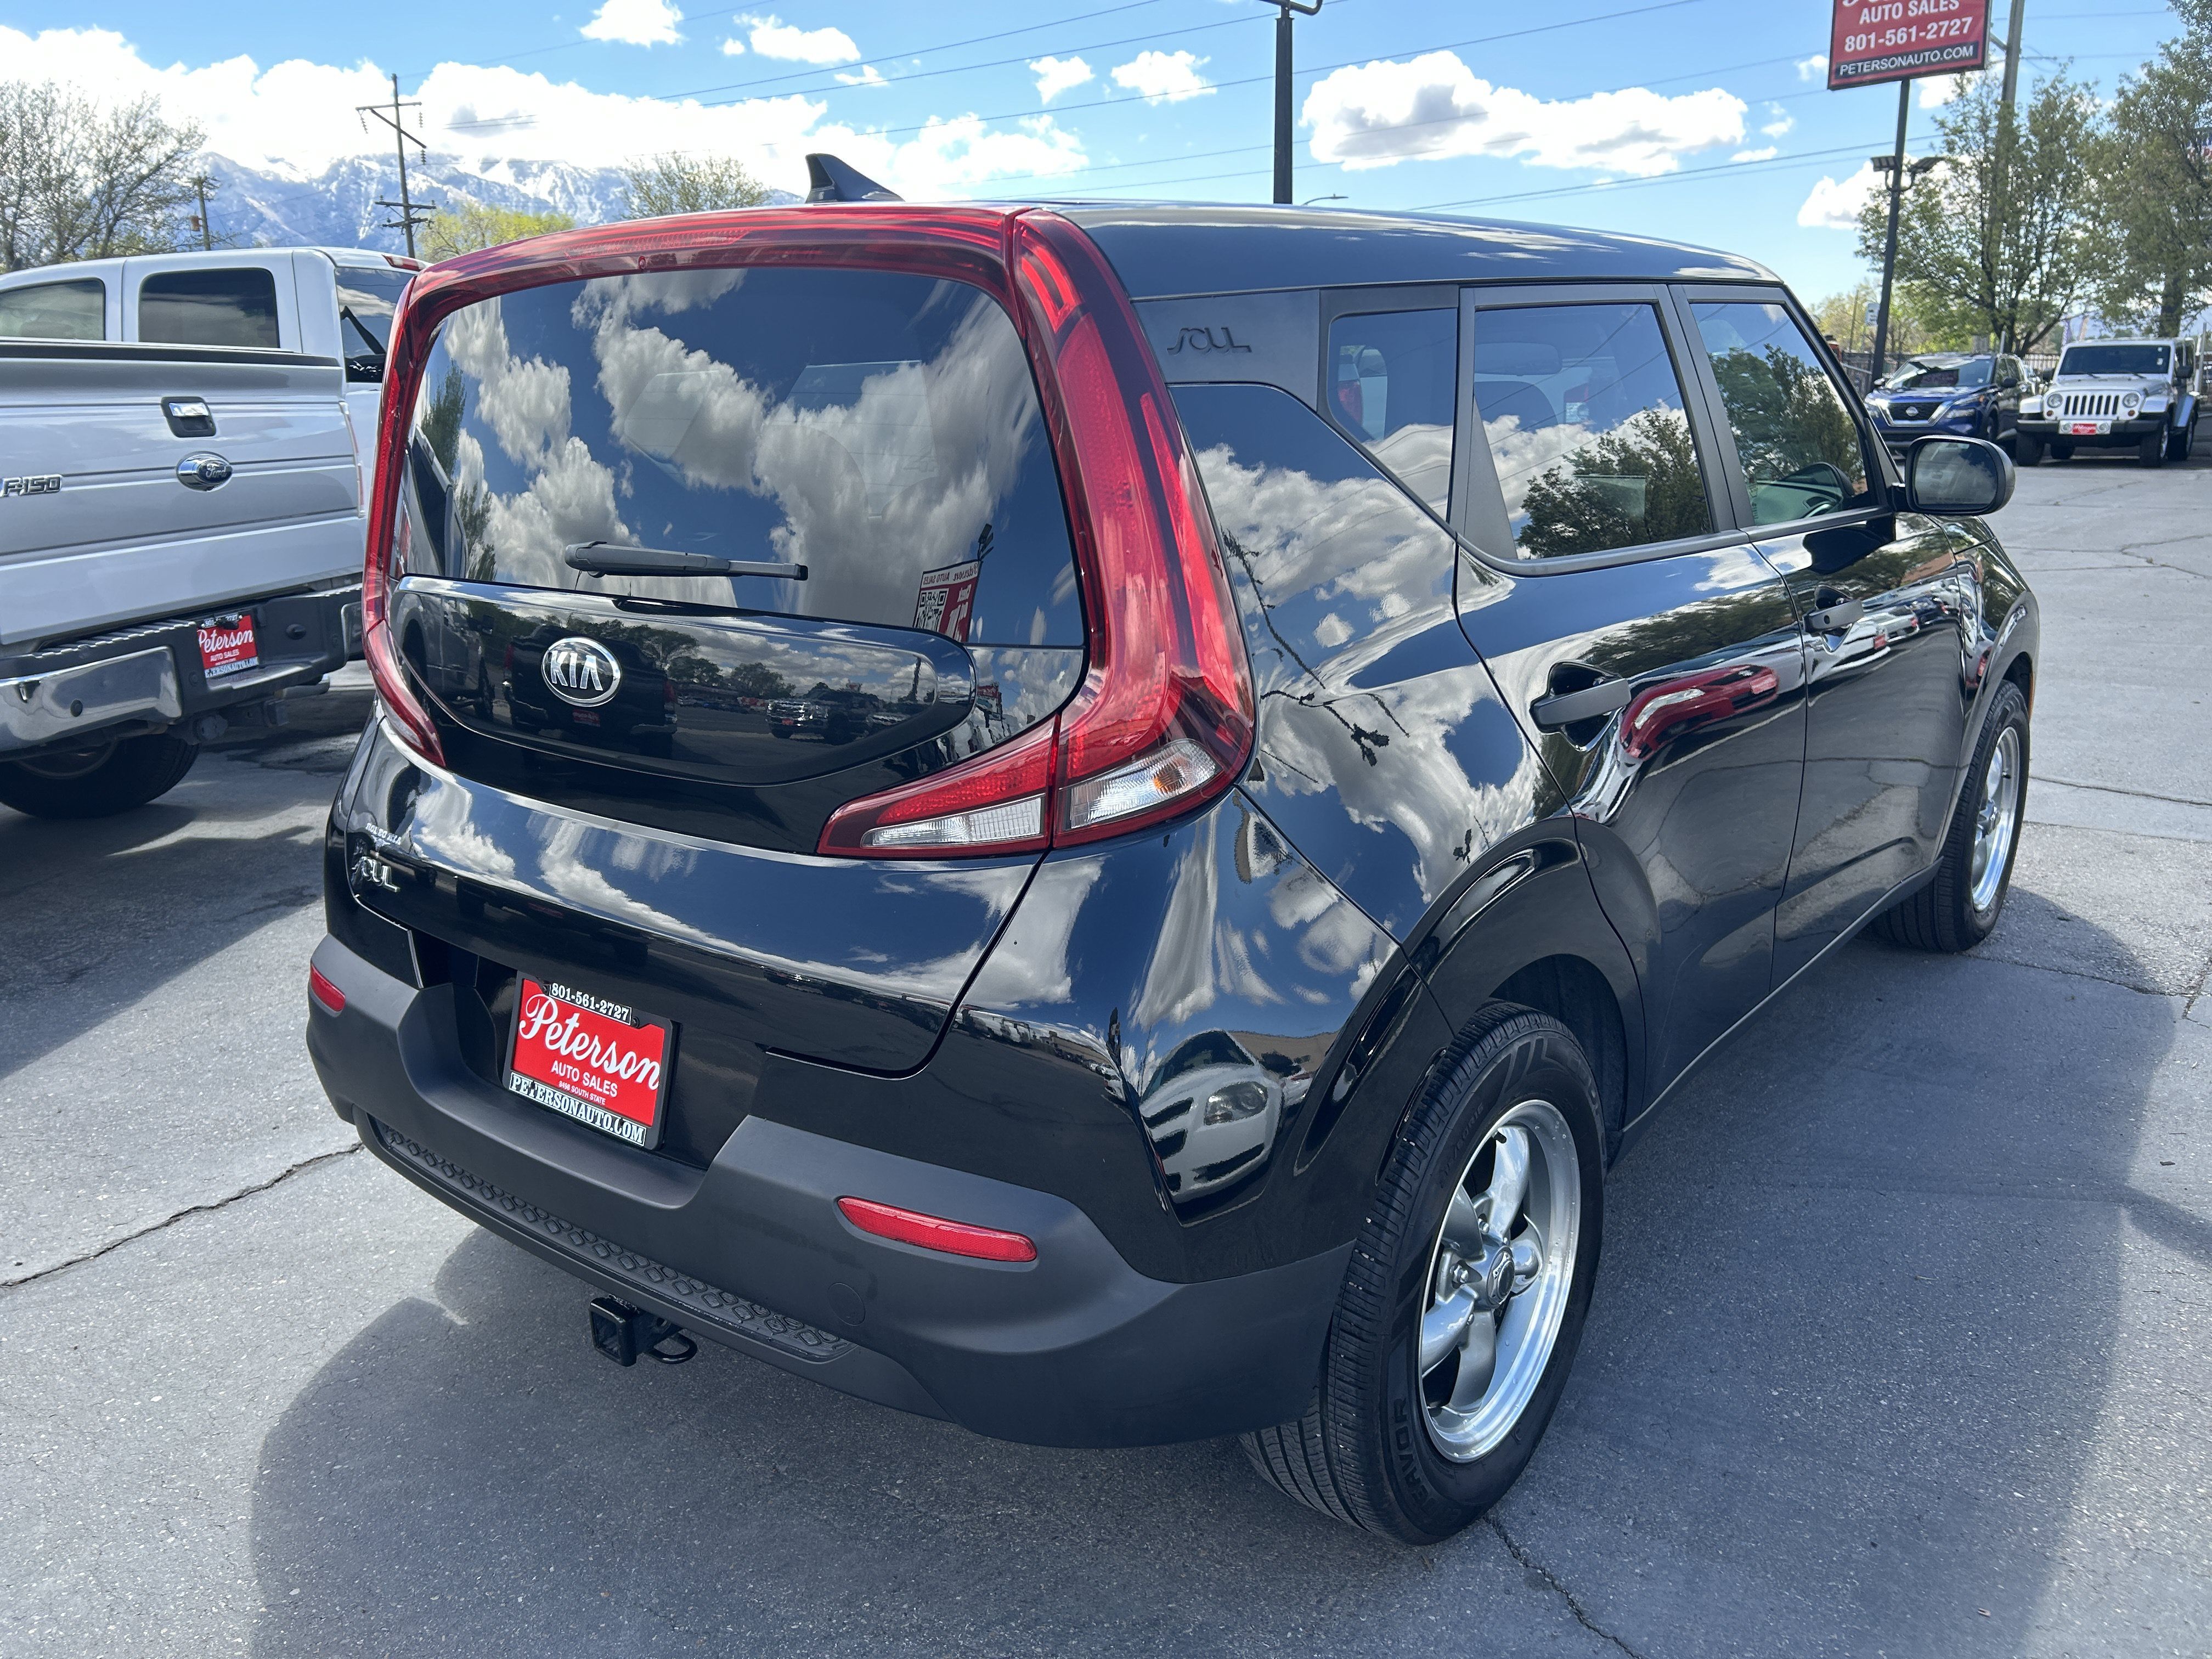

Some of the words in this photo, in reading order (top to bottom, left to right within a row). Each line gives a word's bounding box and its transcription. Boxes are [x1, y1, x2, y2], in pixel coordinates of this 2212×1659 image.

[1859, 2, 1903, 25] AUTO
[1908, 0, 1959, 17] SALES
[1844, 16, 1973, 52] 801-561-2727
[1839, 44, 1973, 76] PETERSONAUTO.COM
[205, 462, 228, 478] Ford
[197, 629, 254, 653] Peterson
[550, 650, 603, 691] KIA
[551, 983, 629, 1022] 801-561-2727
[519, 994, 661, 1090] Peterson
[551, 1060, 580, 1082] AUTO
[582, 1071, 618, 1097] SALES
[571, 1086, 589, 1099] SOUTH
[590, 1093, 606, 1105] STATE
